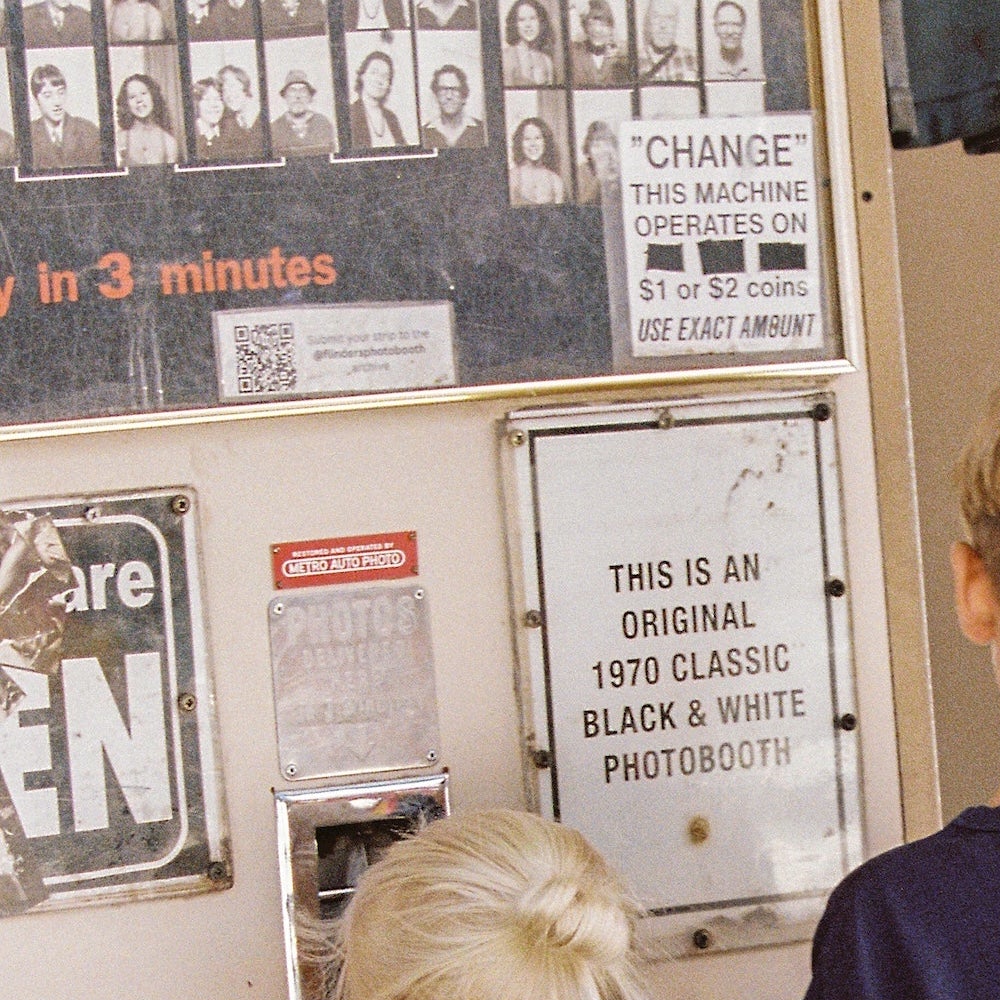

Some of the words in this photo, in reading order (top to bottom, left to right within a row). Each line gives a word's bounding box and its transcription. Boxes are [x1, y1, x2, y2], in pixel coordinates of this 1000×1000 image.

[630, 183, 686, 205] THIS
[695, 181, 809, 204] MACHINE
[634, 213, 764, 236] OPERATES
[772, 212, 807, 234] ON
[38, 262, 79, 303] in
[98, 252, 134, 299] 3
[161, 246, 337, 295] minutes
[639, 278, 665, 301] $1
[677, 282, 699, 300] or
[709, 277, 738, 299] $2
[747, 275, 809, 298] coins
[638, 317, 673, 342] USE
[678, 315, 735, 341] EXACT
[288, 560, 328, 574] METRO
[330, 557, 360, 570] AUTO
[362, 553, 400, 567] PHOTO
[609, 560, 673, 593] THIS
[686, 557, 711, 586] IS
[724, 553, 760, 583] AN
[622, 601, 756, 640] ORIGINAL
[592, 655, 660, 689] 1970
[672, 643, 790, 682] CLASSIC
[583, 701, 676, 739] BLACK
[689, 698, 707, 728] &
[717, 689, 806, 724] WHITE
[604, 736, 791, 784] PHOTOBOOTH
